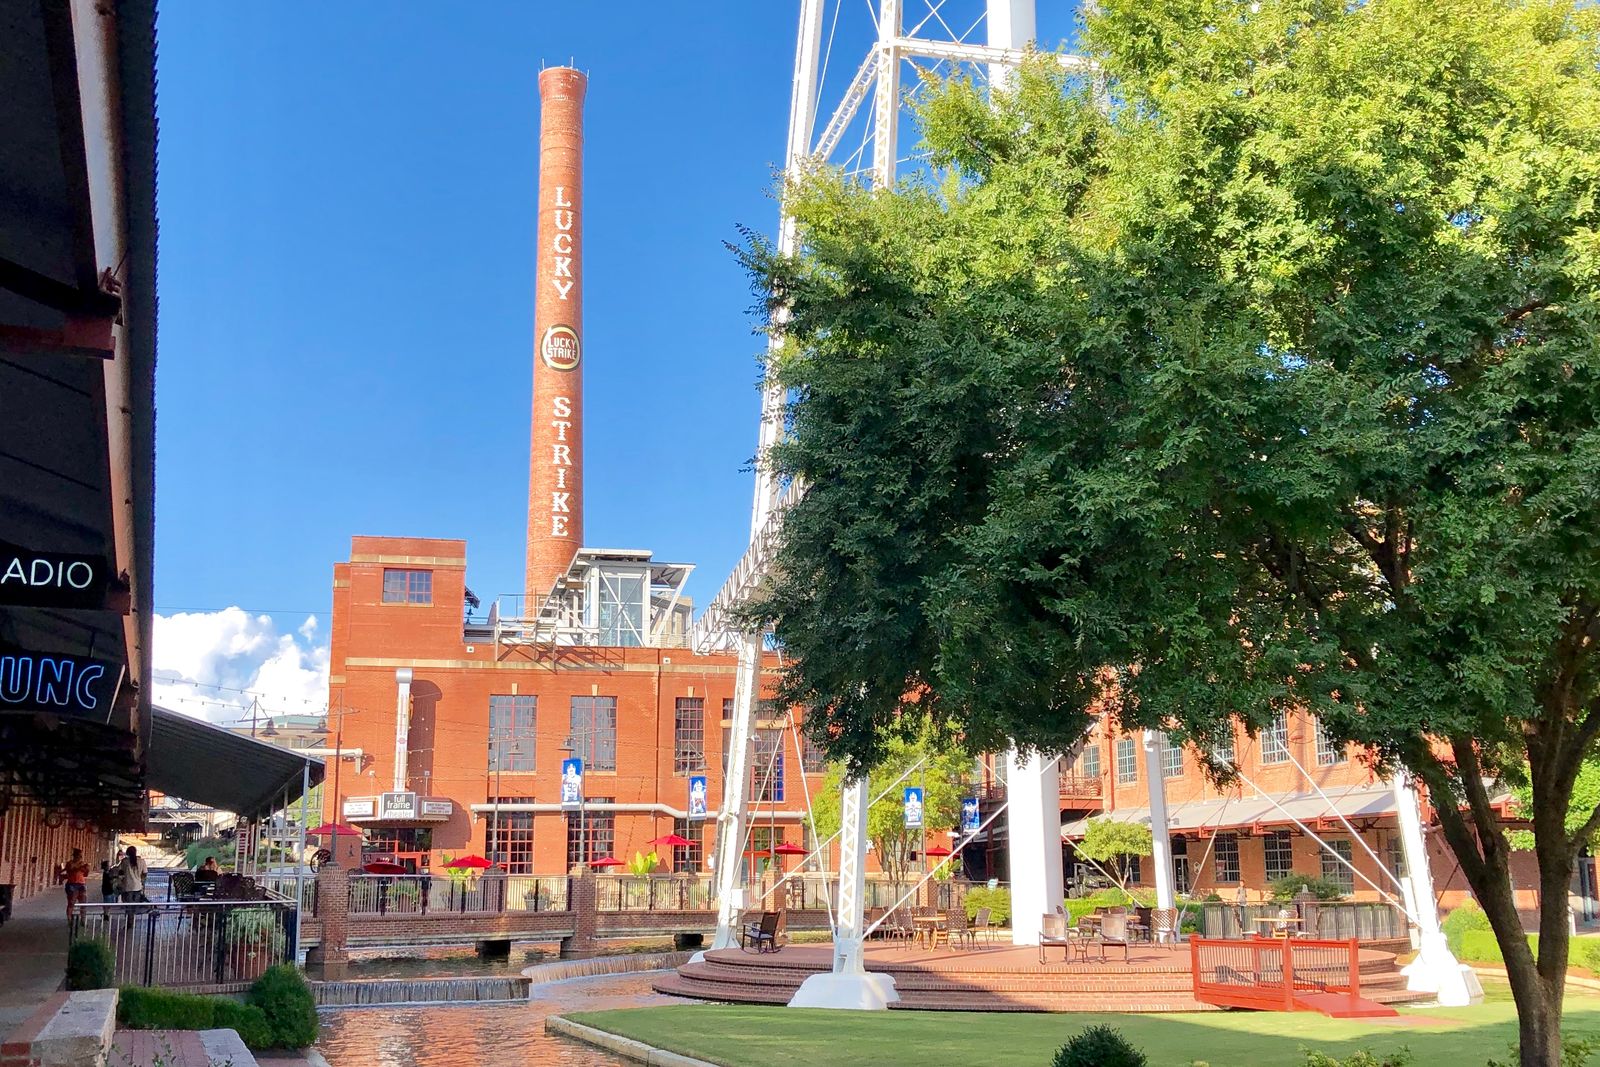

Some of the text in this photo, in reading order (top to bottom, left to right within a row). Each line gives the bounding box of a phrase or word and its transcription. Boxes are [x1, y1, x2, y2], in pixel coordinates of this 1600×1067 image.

[553, 186, 574, 300] LUCKY
[547, 347, 577, 360] STRIKE
[548, 336, 576, 349] LUCKY
[551, 396, 573, 537] STRIKE
[1, 557, 93, 589] ADIO
[0, 656, 105, 710] UNC
[387, 800, 411, 809] frame
[394, 794, 406, 802] full
